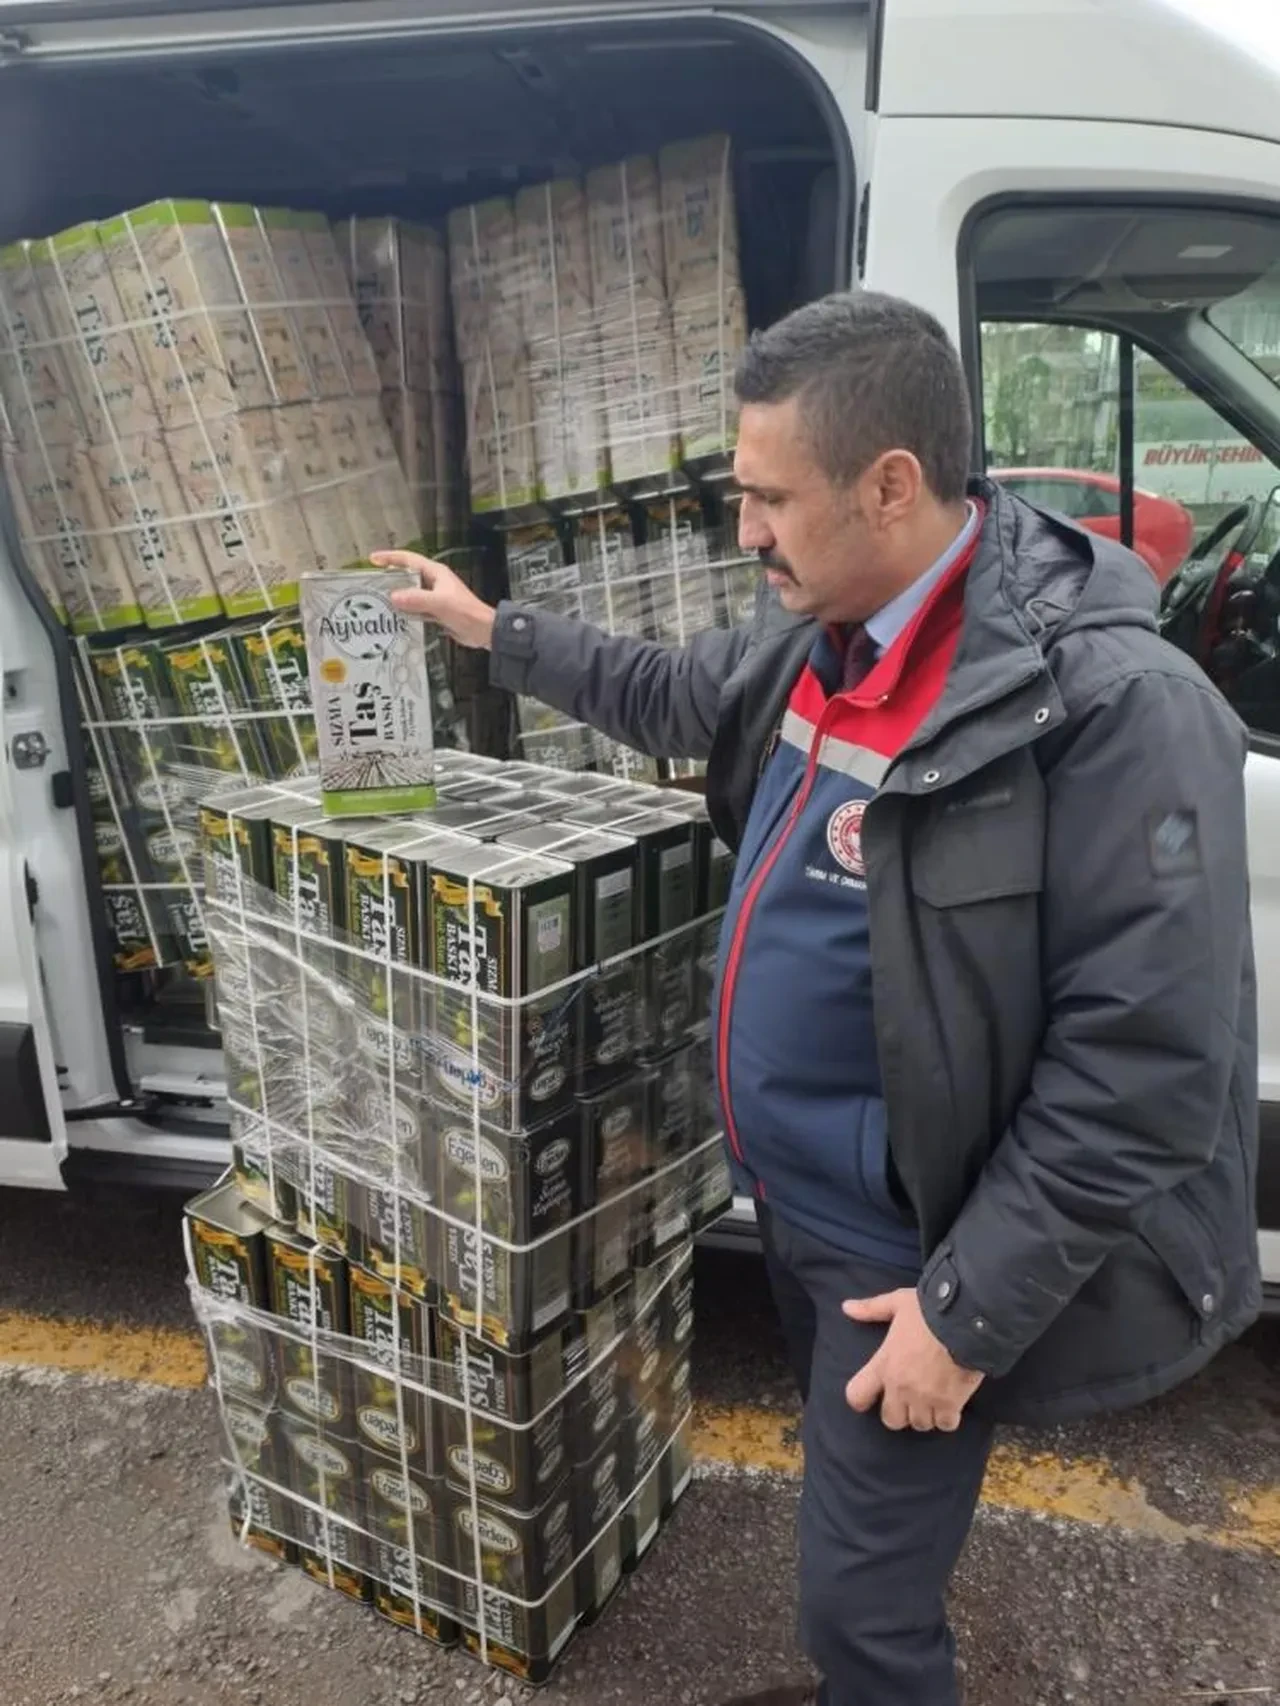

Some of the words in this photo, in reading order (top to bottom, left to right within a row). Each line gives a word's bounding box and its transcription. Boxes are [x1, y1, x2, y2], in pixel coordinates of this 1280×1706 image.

[319, 613, 407, 642] Ayvalık
[327, 696, 344, 748] SIZMA
[350, 682, 381, 746] Taş
[381, 694, 395, 741] BASKI
